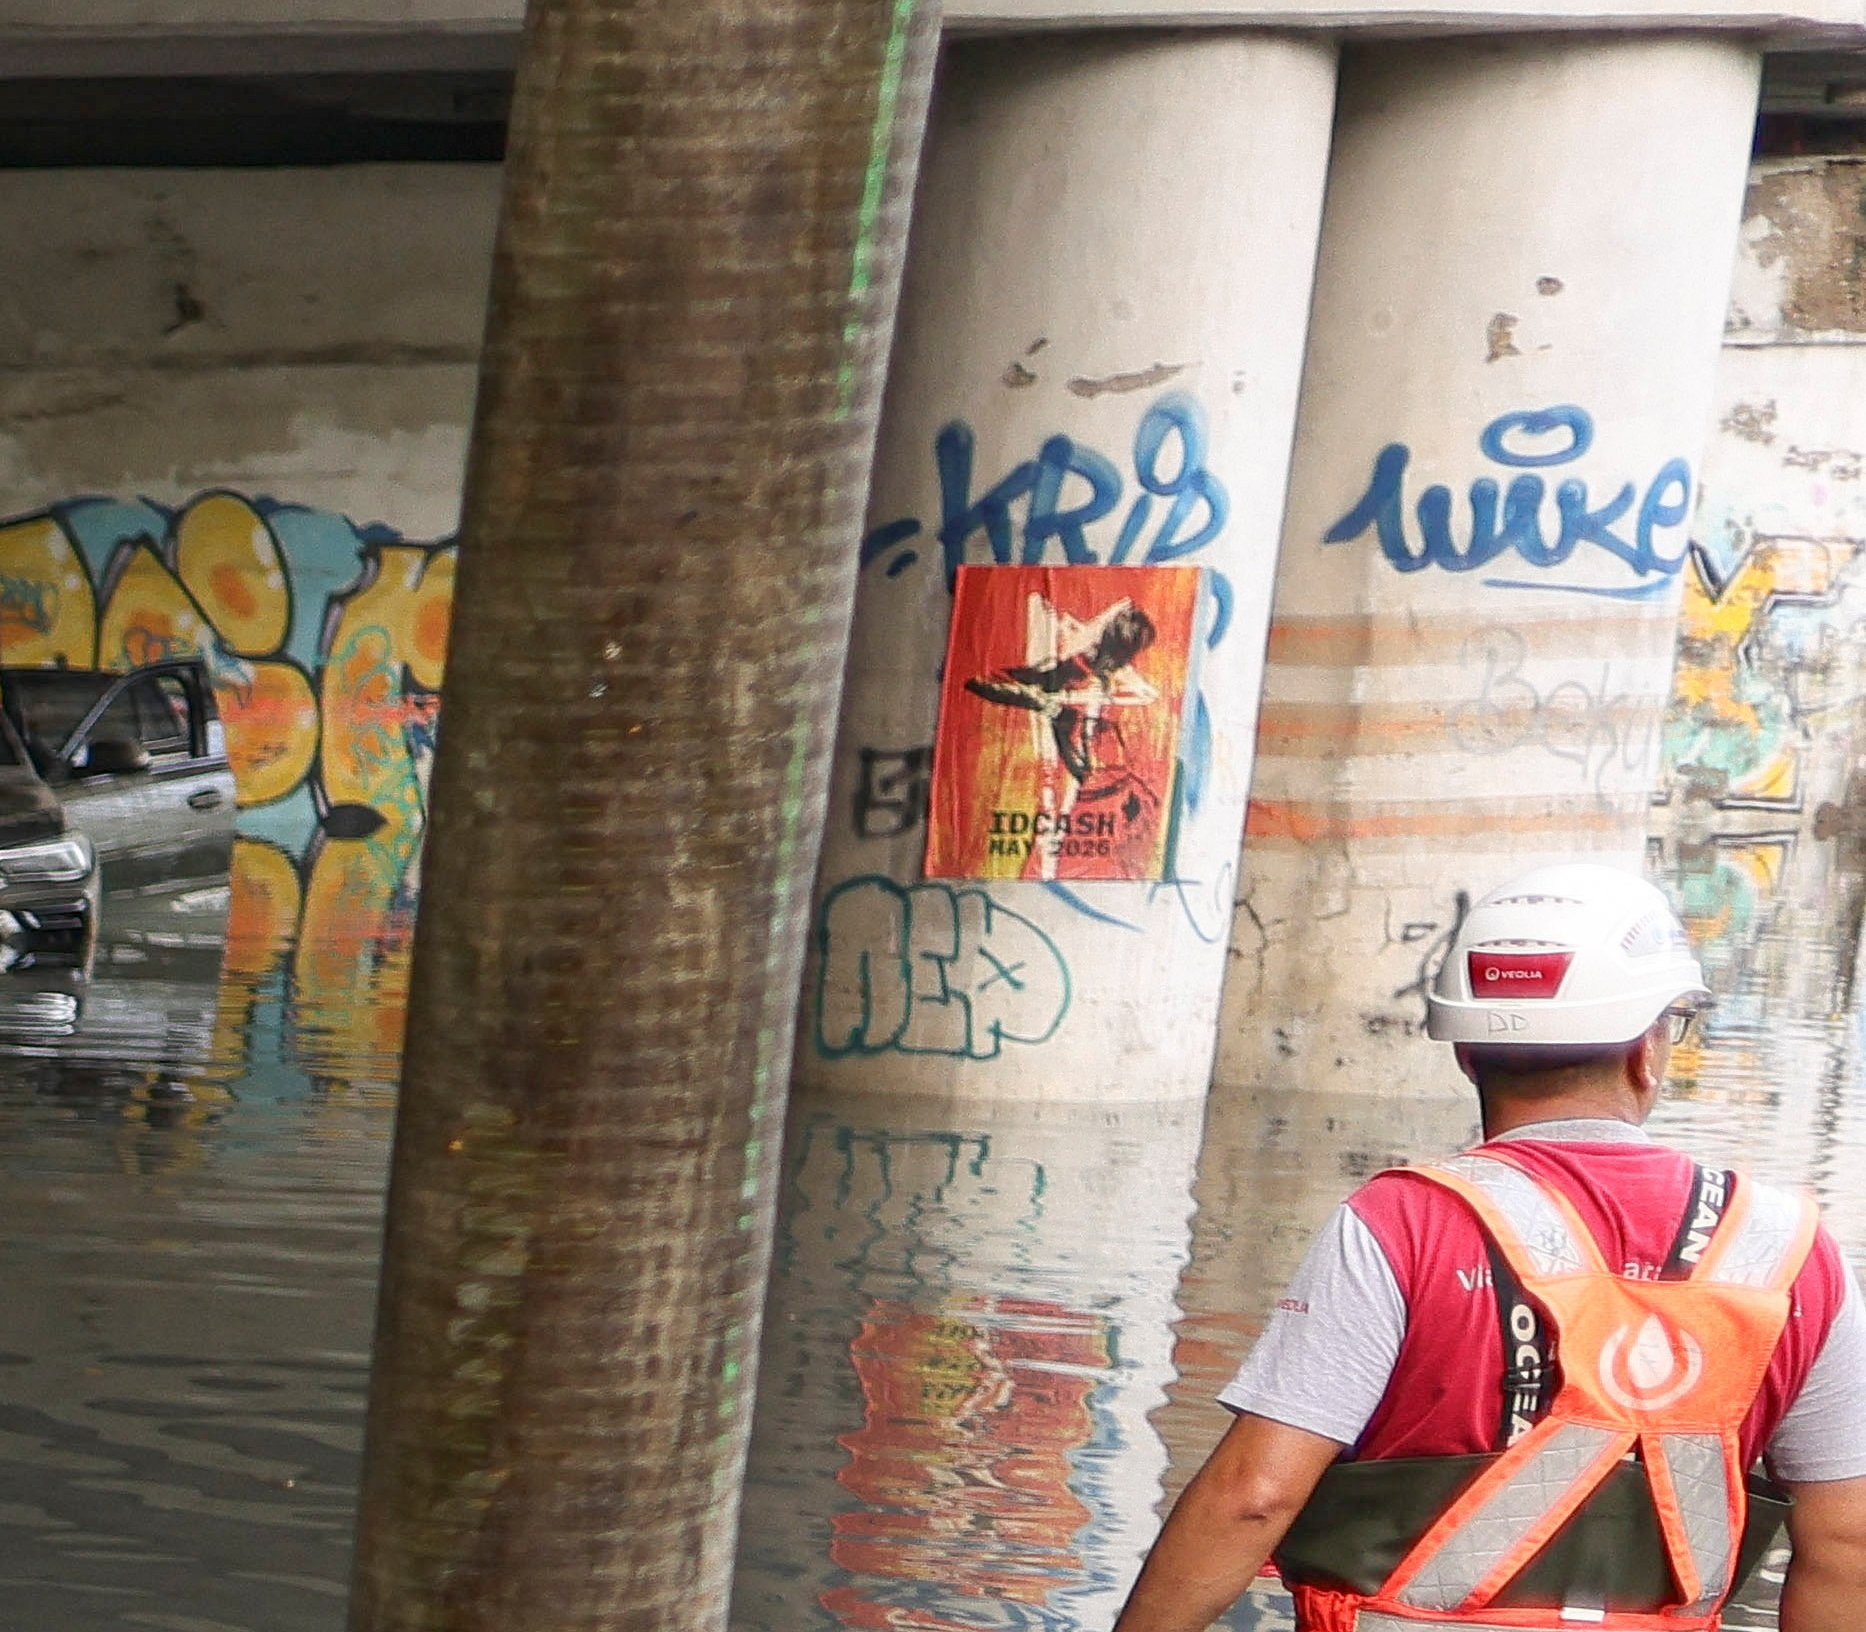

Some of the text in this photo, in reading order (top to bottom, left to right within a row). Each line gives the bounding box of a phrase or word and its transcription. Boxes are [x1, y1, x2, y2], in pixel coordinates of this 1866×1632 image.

[989, 812, 1115, 835] IDCASH
[989, 839, 1033, 856] MAY
[1501, 969, 1543, 979] VEOLIA
[1679, 1168, 1726, 1264] CEAN
[1507, 1304, 1542, 1448] OCEA
